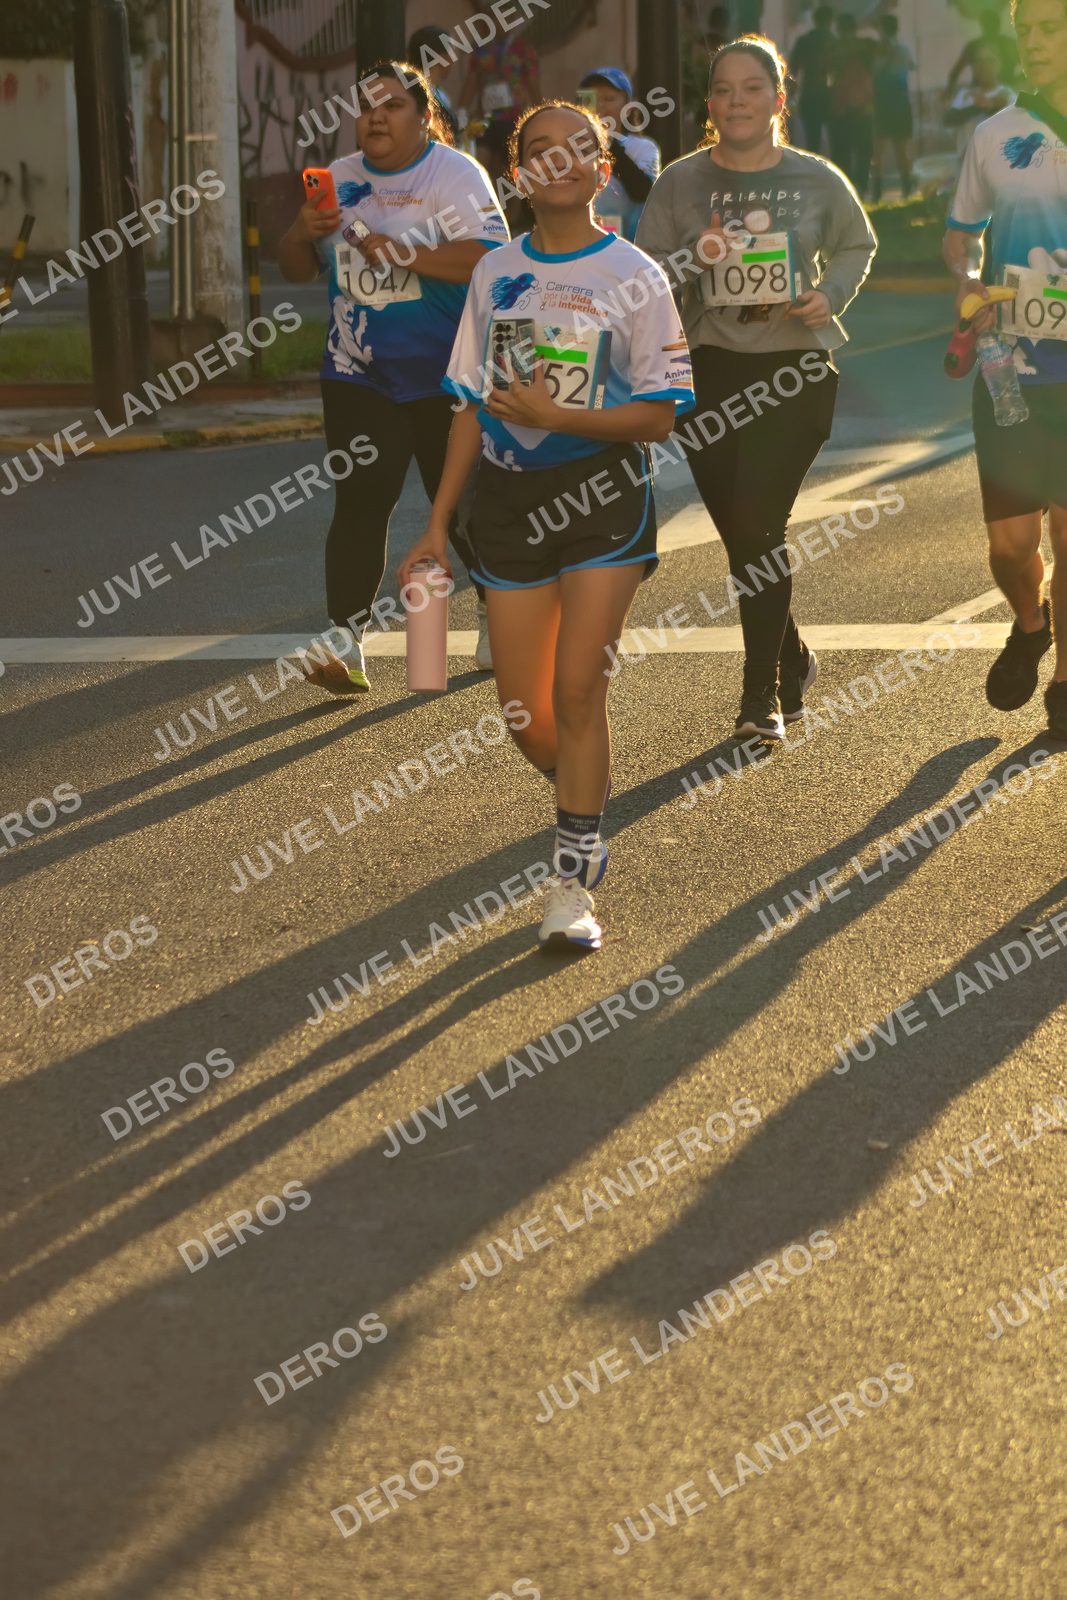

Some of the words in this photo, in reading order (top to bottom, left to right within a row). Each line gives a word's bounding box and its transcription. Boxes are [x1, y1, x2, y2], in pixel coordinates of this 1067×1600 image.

[710, 262, 788, 297] 1098
[546, 281, 594, 297] Carrera
[571, 294, 593, 305] Vida
[558, 300, 609, 318] Integridad
